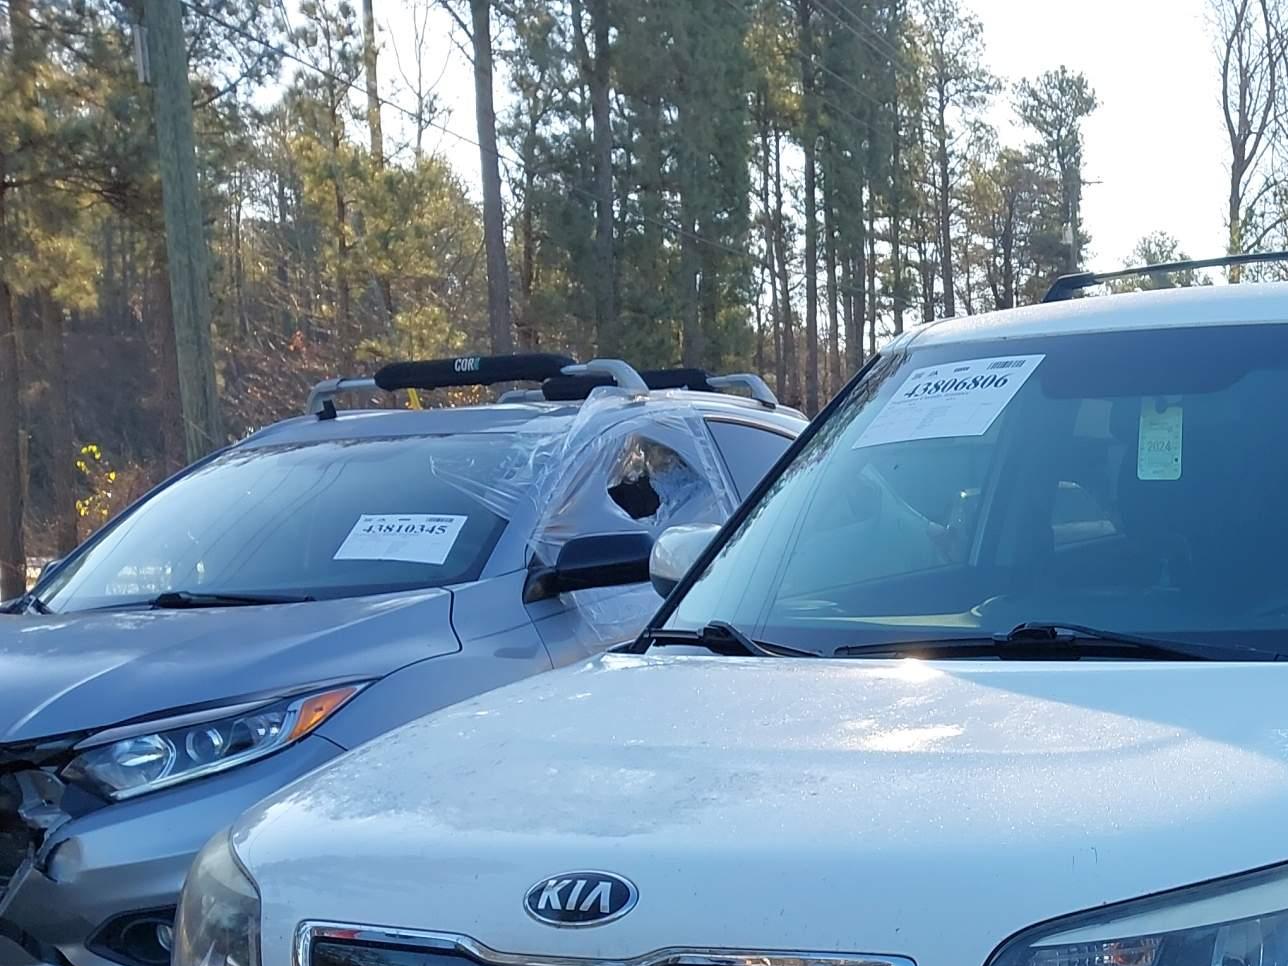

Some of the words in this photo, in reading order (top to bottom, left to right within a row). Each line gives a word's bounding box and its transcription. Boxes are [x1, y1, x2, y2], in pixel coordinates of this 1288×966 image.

[904, 372, 1012, 398] 43806806
[1147, 440, 1170, 451] 2024
[362, 524, 448, 535] 43810345
[537, 879, 613, 914] KIA
